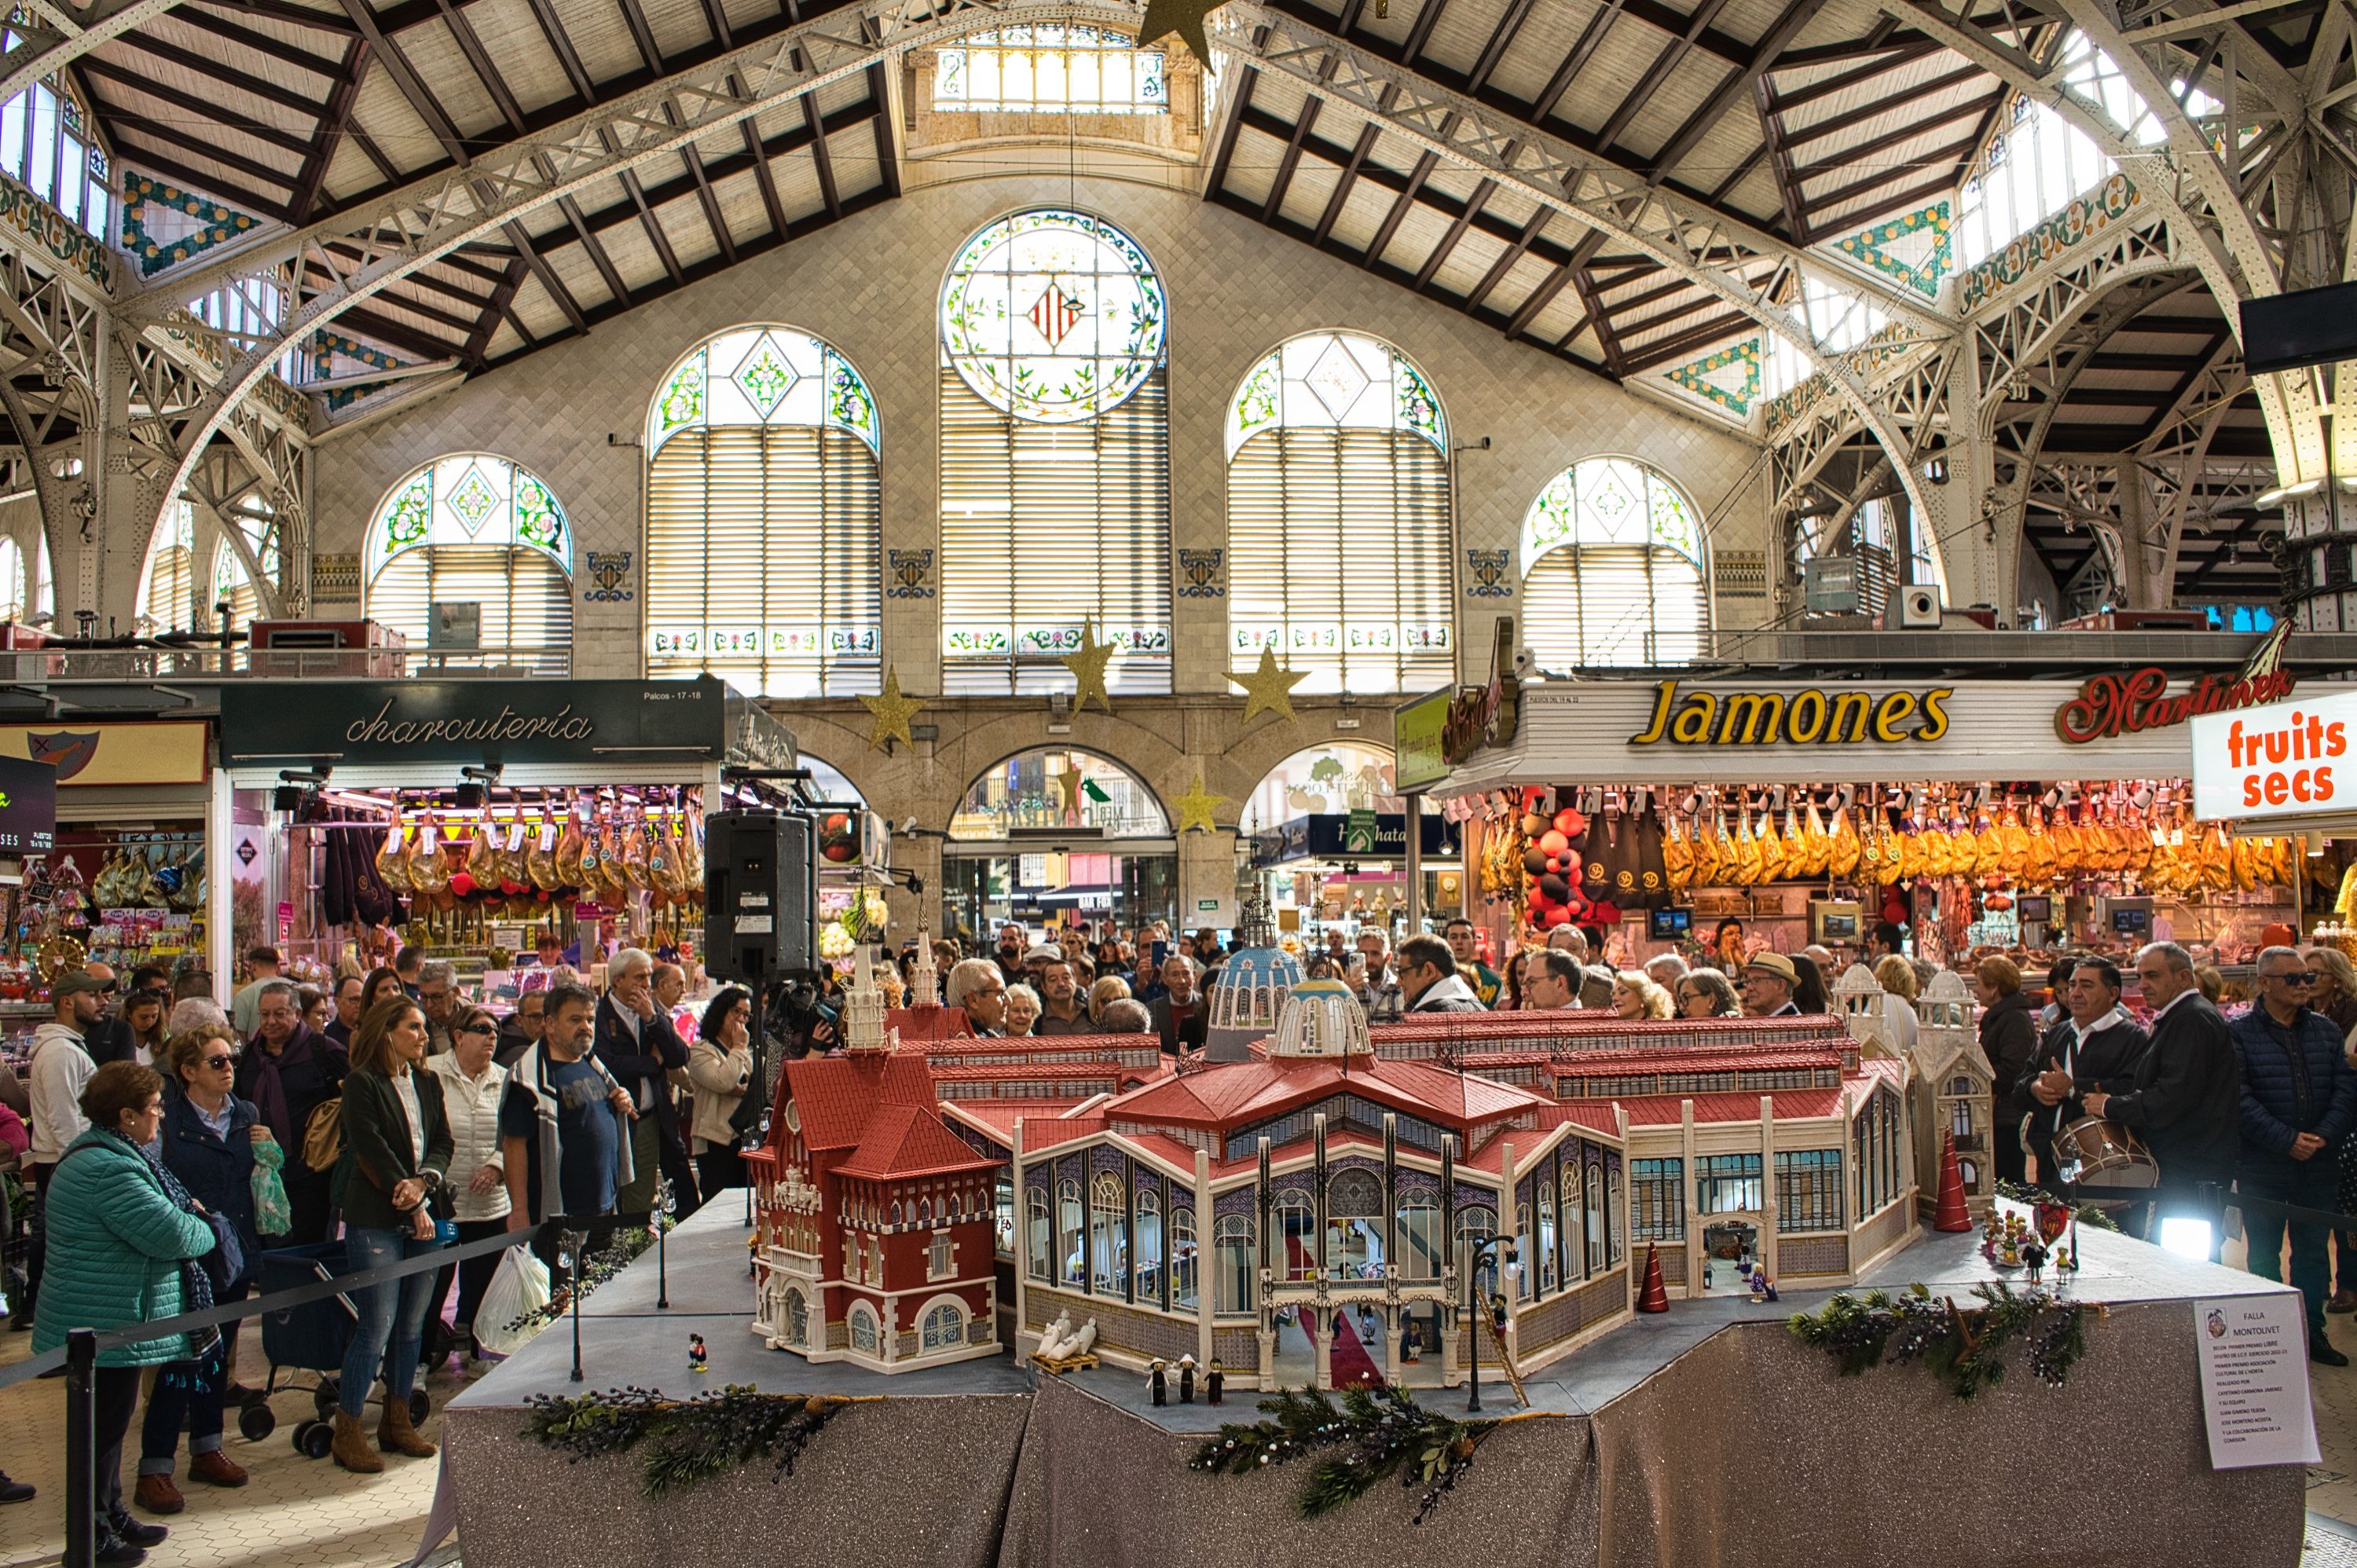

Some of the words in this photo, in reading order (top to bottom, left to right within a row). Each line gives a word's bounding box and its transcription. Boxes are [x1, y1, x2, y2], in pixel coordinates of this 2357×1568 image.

[346, 699, 592, 743] charcutería
[1627, 680, 1954, 745] Jamones
[2228, 711, 2347, 768] fruits
[2243, 767, 2334, 808] secs
[1079, 897, 1094, 908] BAR
[2233, 1326, 2280, 1336] MONTOLIVET
